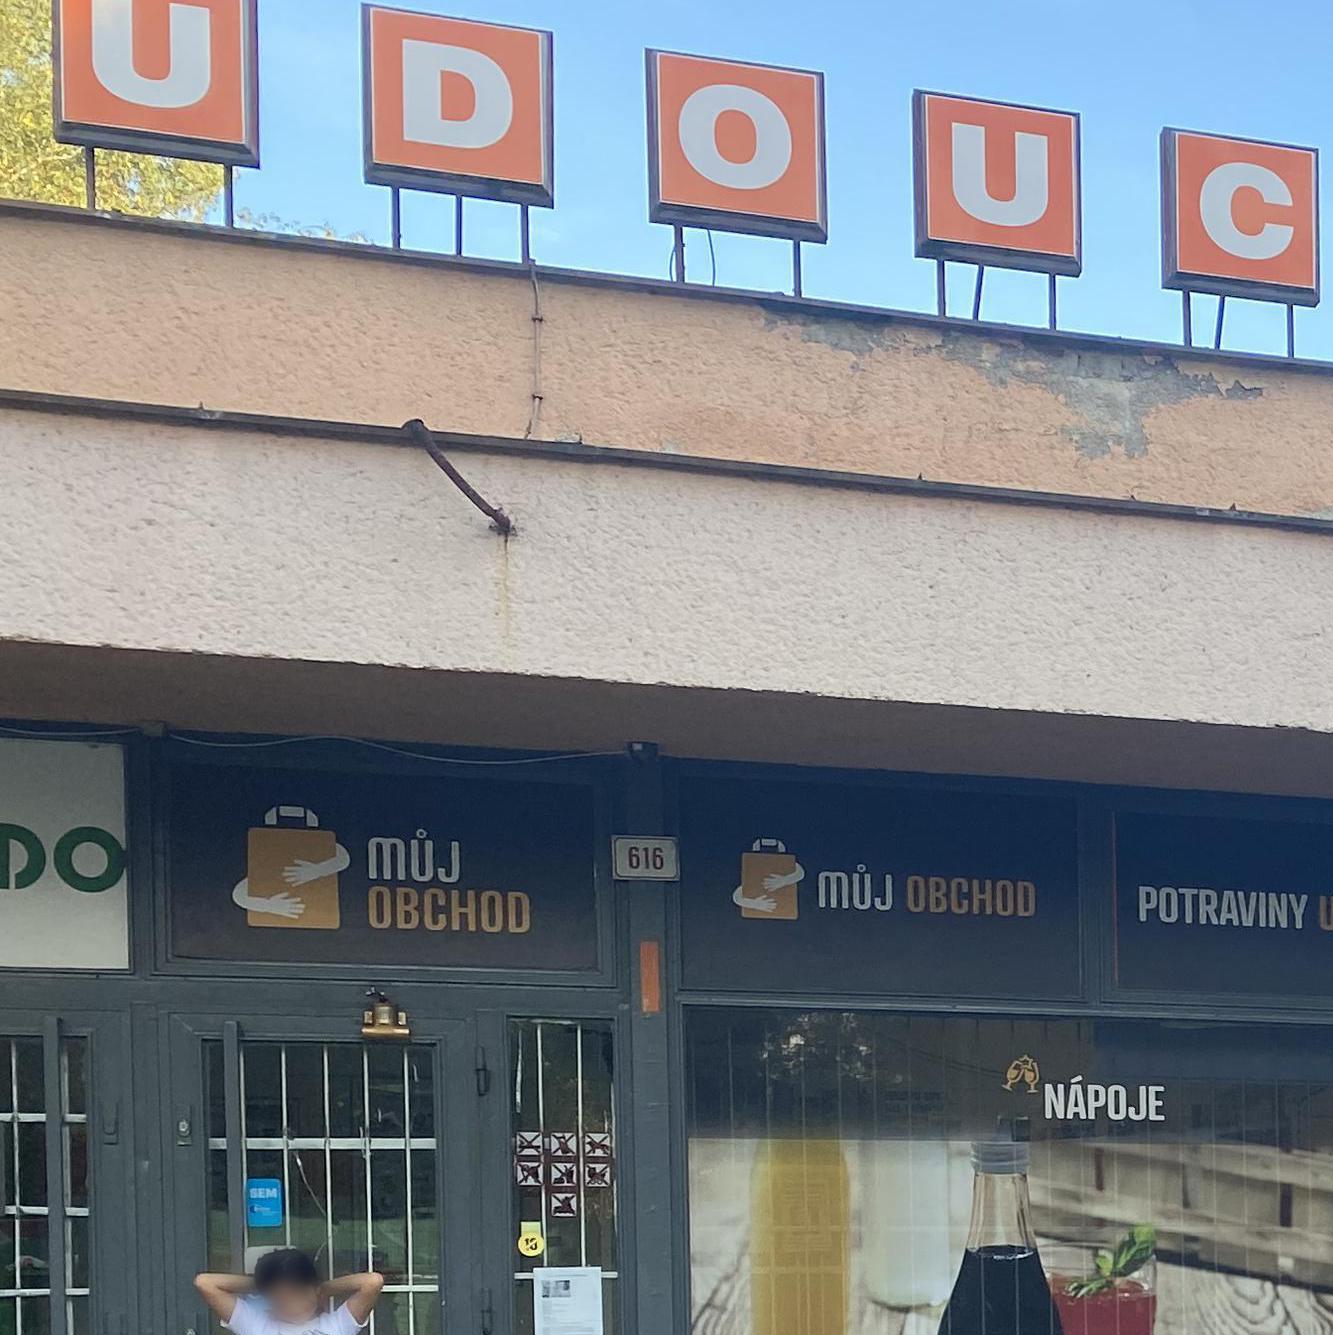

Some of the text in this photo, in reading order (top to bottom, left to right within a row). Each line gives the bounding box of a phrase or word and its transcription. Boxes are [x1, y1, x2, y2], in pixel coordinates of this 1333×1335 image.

[367, 829, 460, 883] MŮJ
[627, 846, 664, 871] 616
[368, 886, 531, 933] OBCHOD
[817, 864, 1036, 917] MŮJ OBCHOD
[1138, 886, 1307, 929] POTRAVINY
[1043, 1075, 1166, 1122] NÁPOJE
